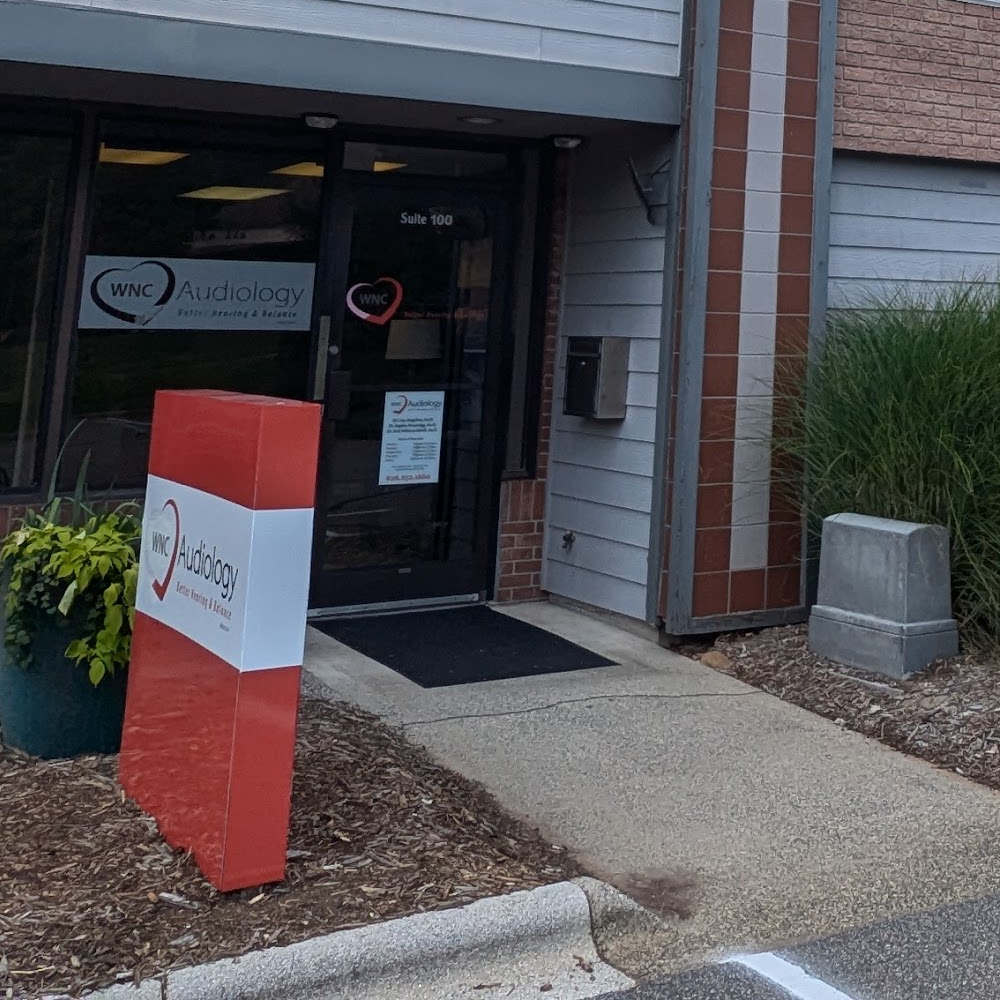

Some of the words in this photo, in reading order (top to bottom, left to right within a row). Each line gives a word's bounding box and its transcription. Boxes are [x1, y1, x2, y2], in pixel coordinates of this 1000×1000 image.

[400, 211, 428, 225] Suite
[430, 213, 454, 226] 100
[110, 282, 154, 298] WNC
[176, 279, 305, 309] Audiology
[359, 293, 389, 305] WNC
[407, 399, 442, 408] Audiology
[151, 530, 171, 557] WNC
[176, 533, 239, 602] Audiology
